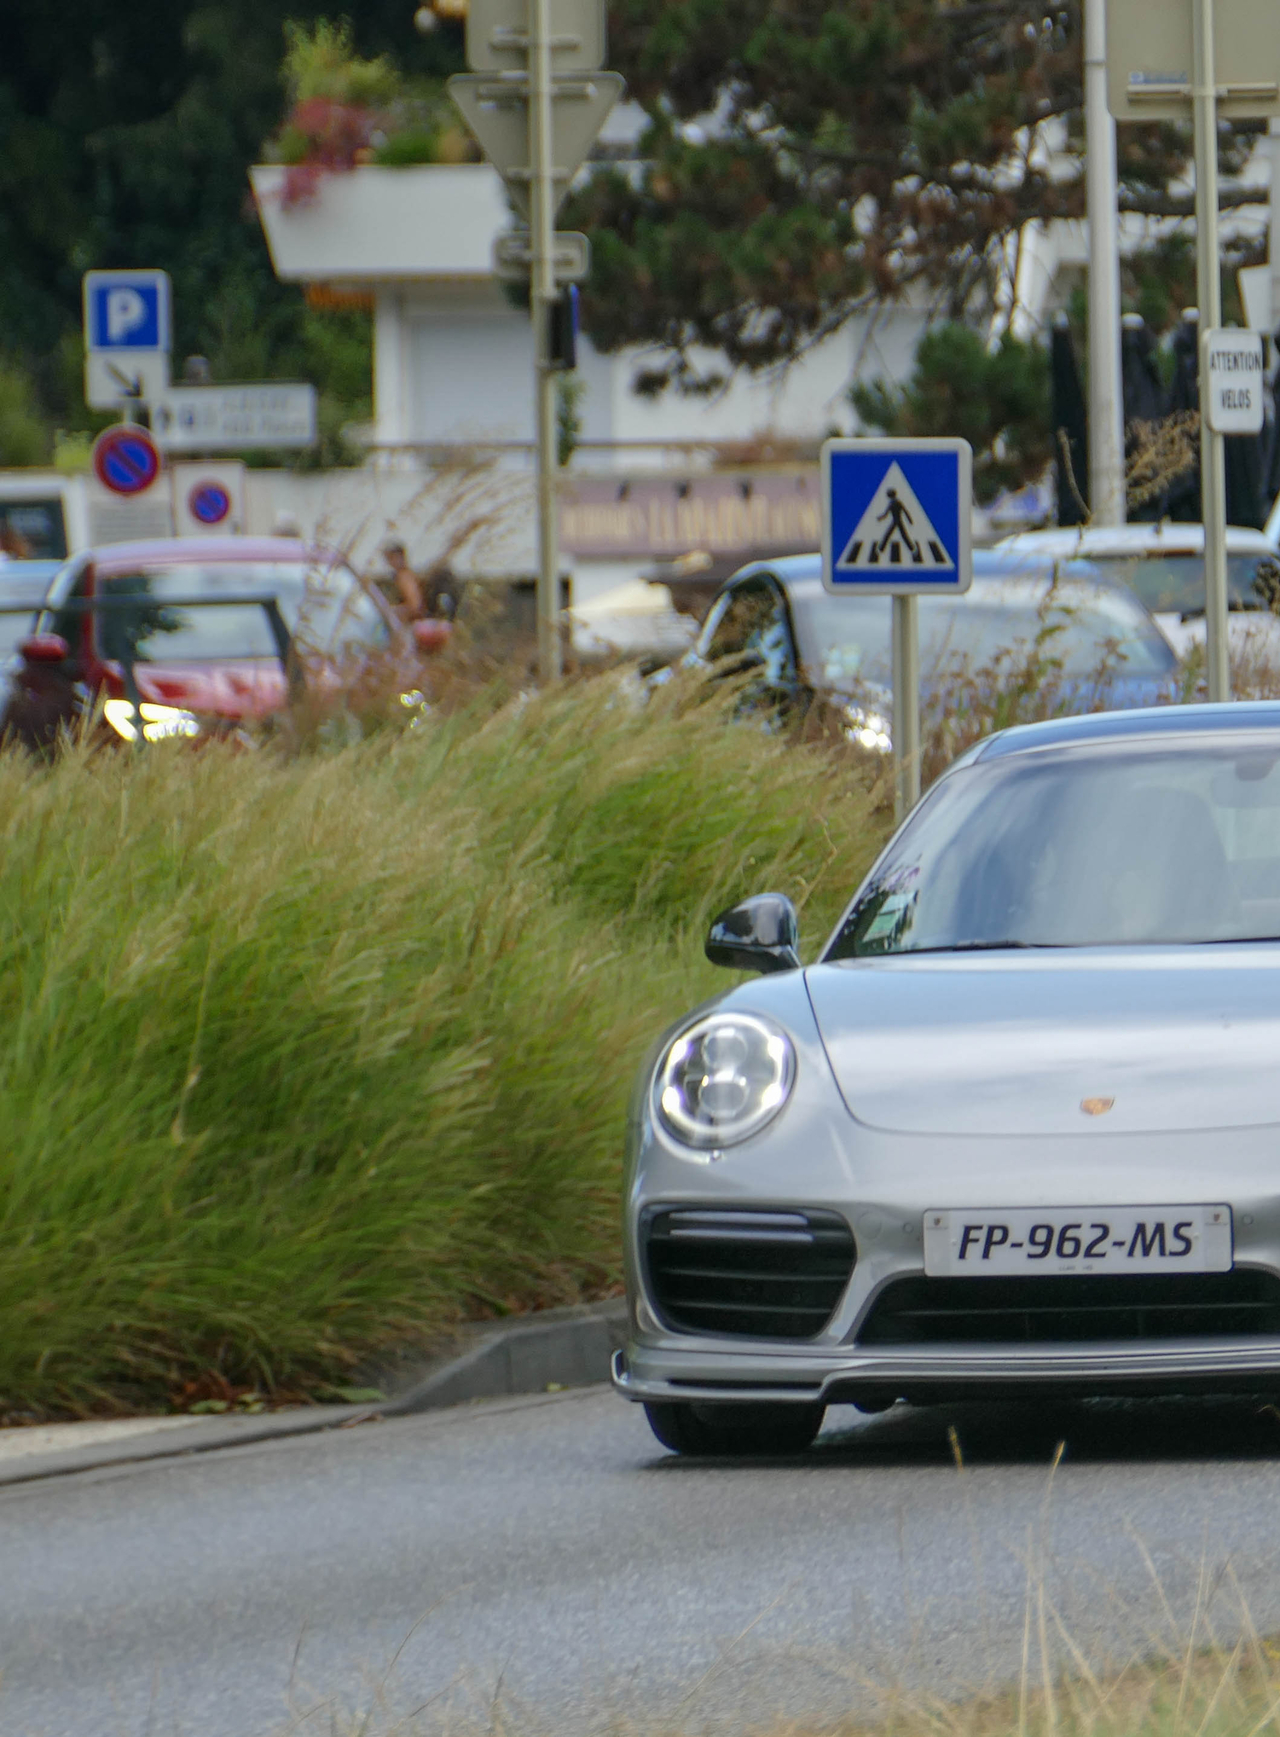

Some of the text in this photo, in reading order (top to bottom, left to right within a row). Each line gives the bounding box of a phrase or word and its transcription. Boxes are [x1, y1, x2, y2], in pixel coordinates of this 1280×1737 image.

[106, 288, 146, 342] P
[1210, 351, 1262, 372] ATTENTION
[957, 1221, 1193, 1260] FP-962-MS
